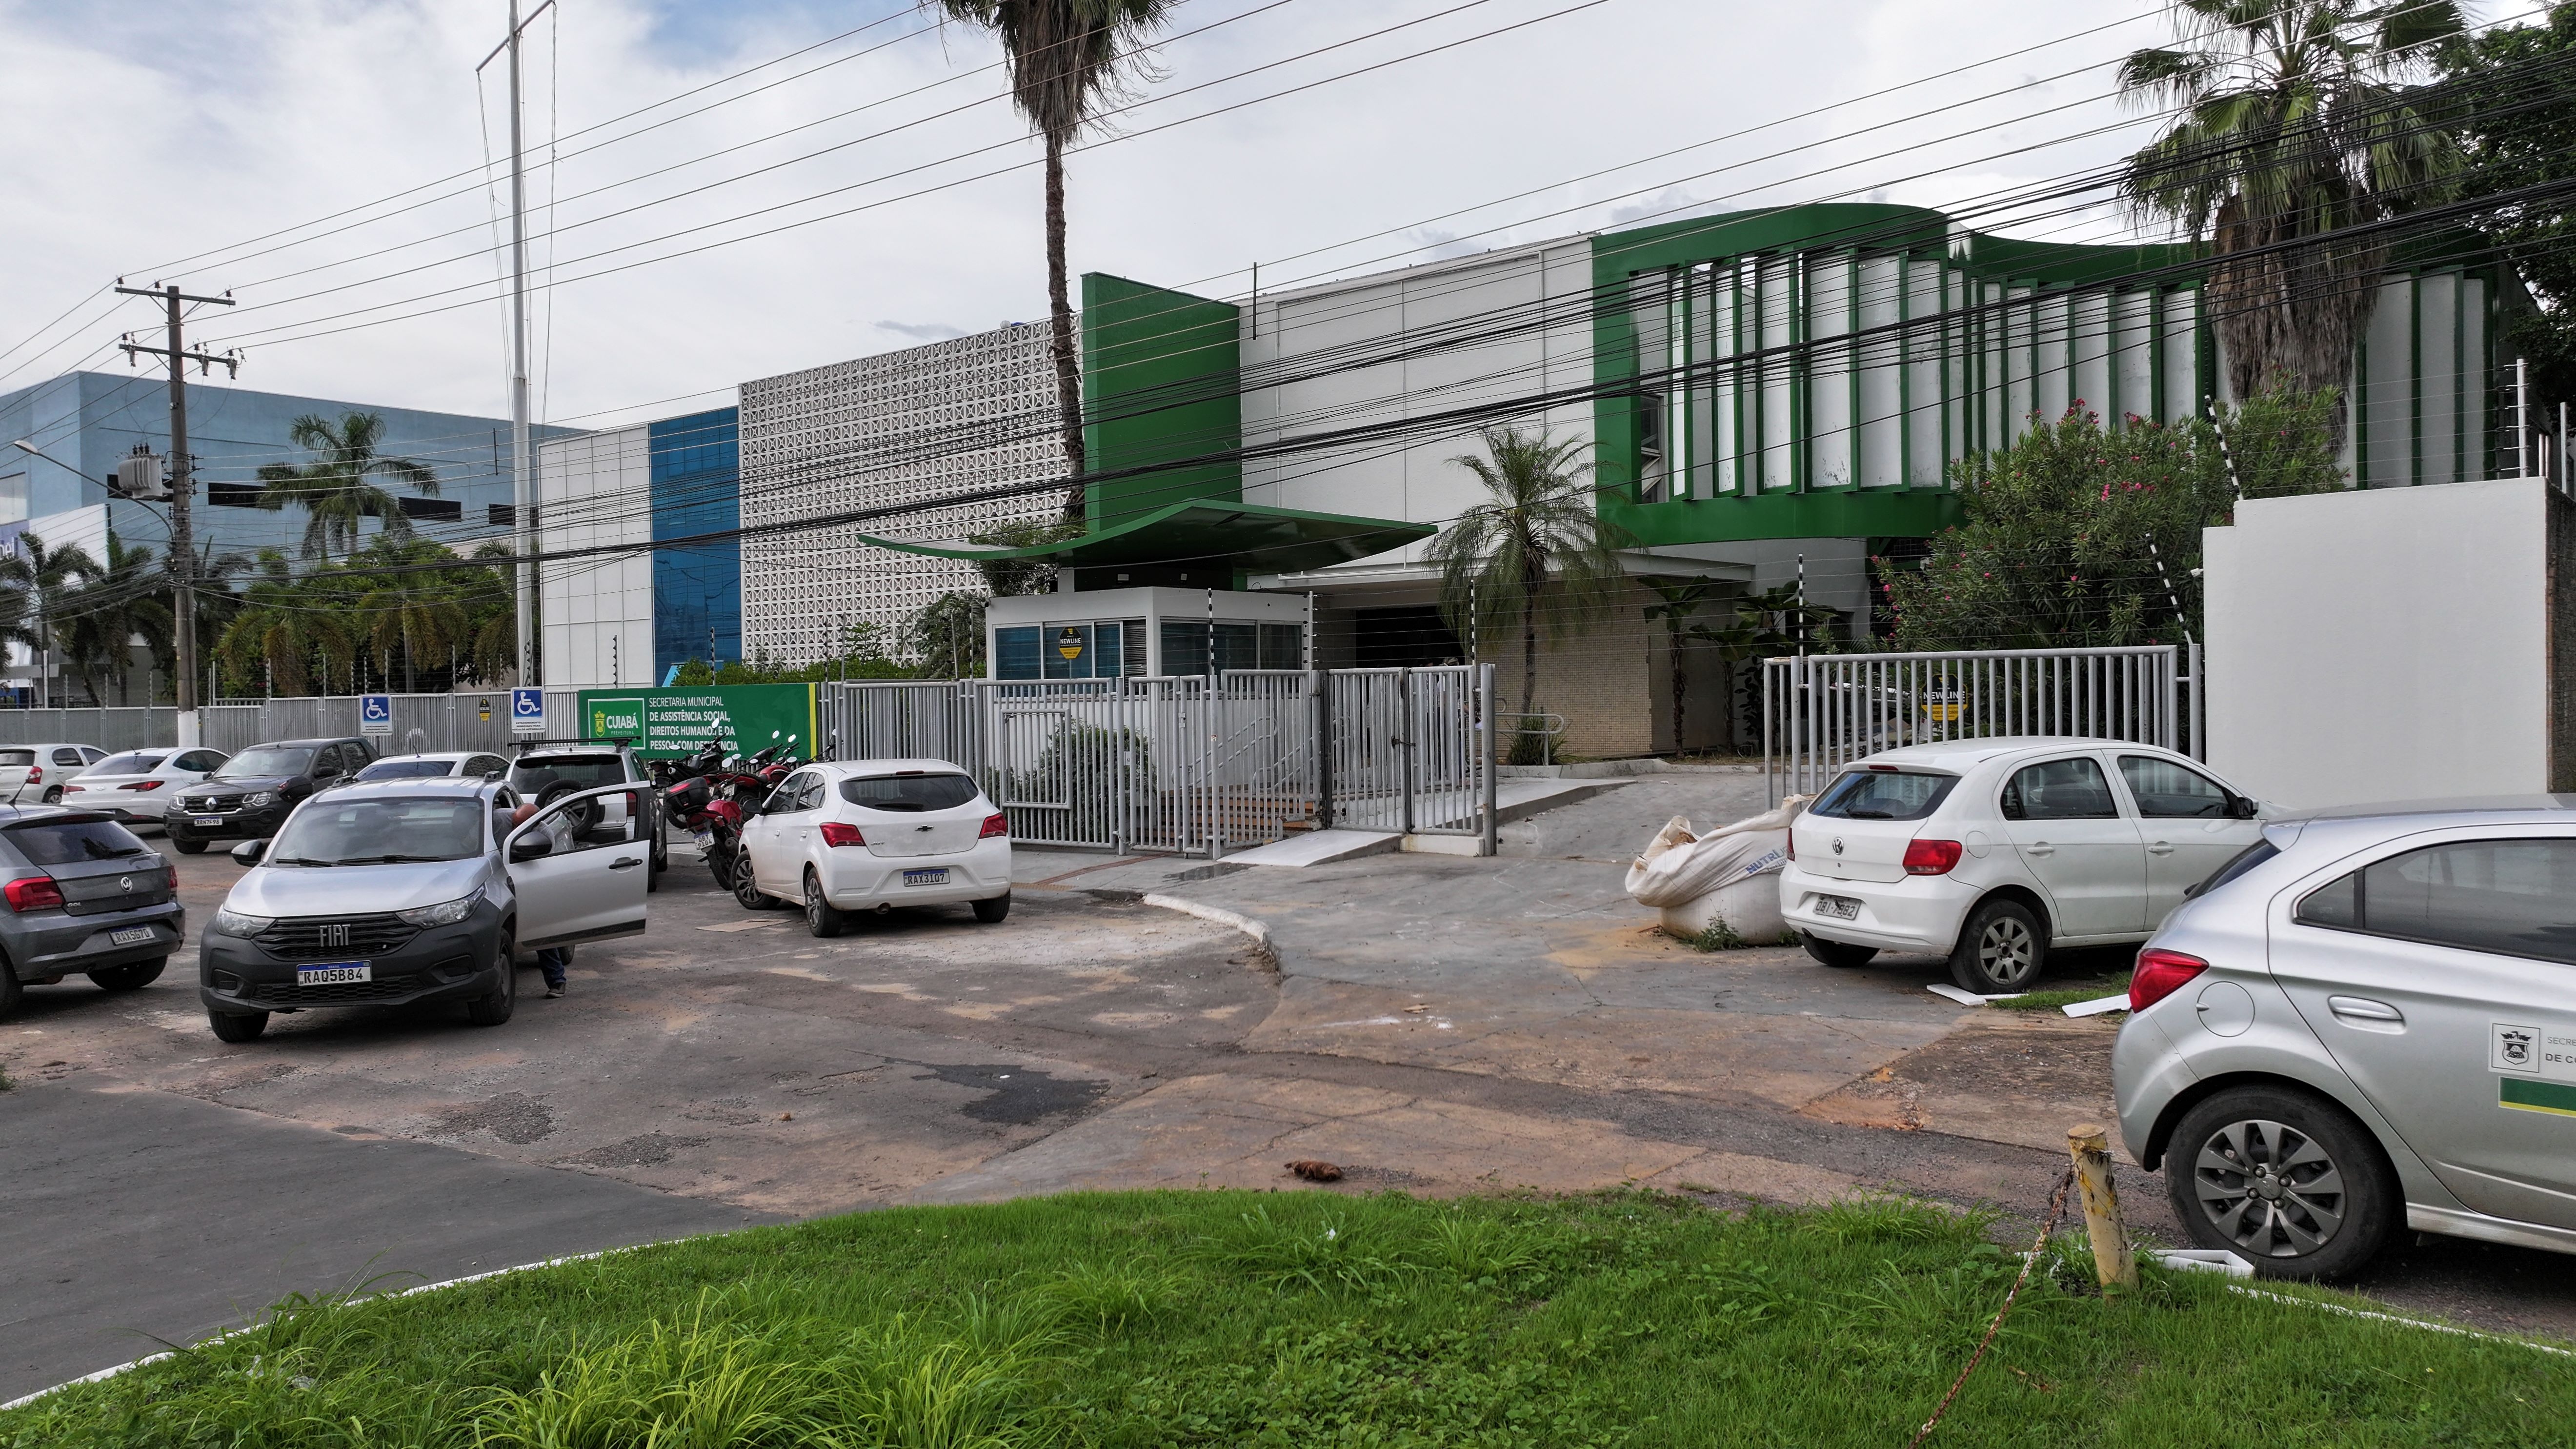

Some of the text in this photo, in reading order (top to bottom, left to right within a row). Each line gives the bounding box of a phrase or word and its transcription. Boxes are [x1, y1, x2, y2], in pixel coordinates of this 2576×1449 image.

[1923, 691, 1965, 699] NEWIN
[649, 696, 724, 707] SECRETARIA MUNICIPAL
[606, 712, 639, 728] CUIABÁ
[649, 709, 730, 722] DE ASSISTÊNCIA SOCIAL,
[650, 726, 679, 736] DIREITOS
[718, 726, 723, 736] E
[724, 725, 735, 736] DA
[115, 928, 150, 943] RAX5G70
[320, 924, 351, 947] FIAT
[304, 968, 363, 984] RAQ5B84
[2547, 1036, 2576, 1046] SECRE
[2545, 1053, 2562, 1063] DE
